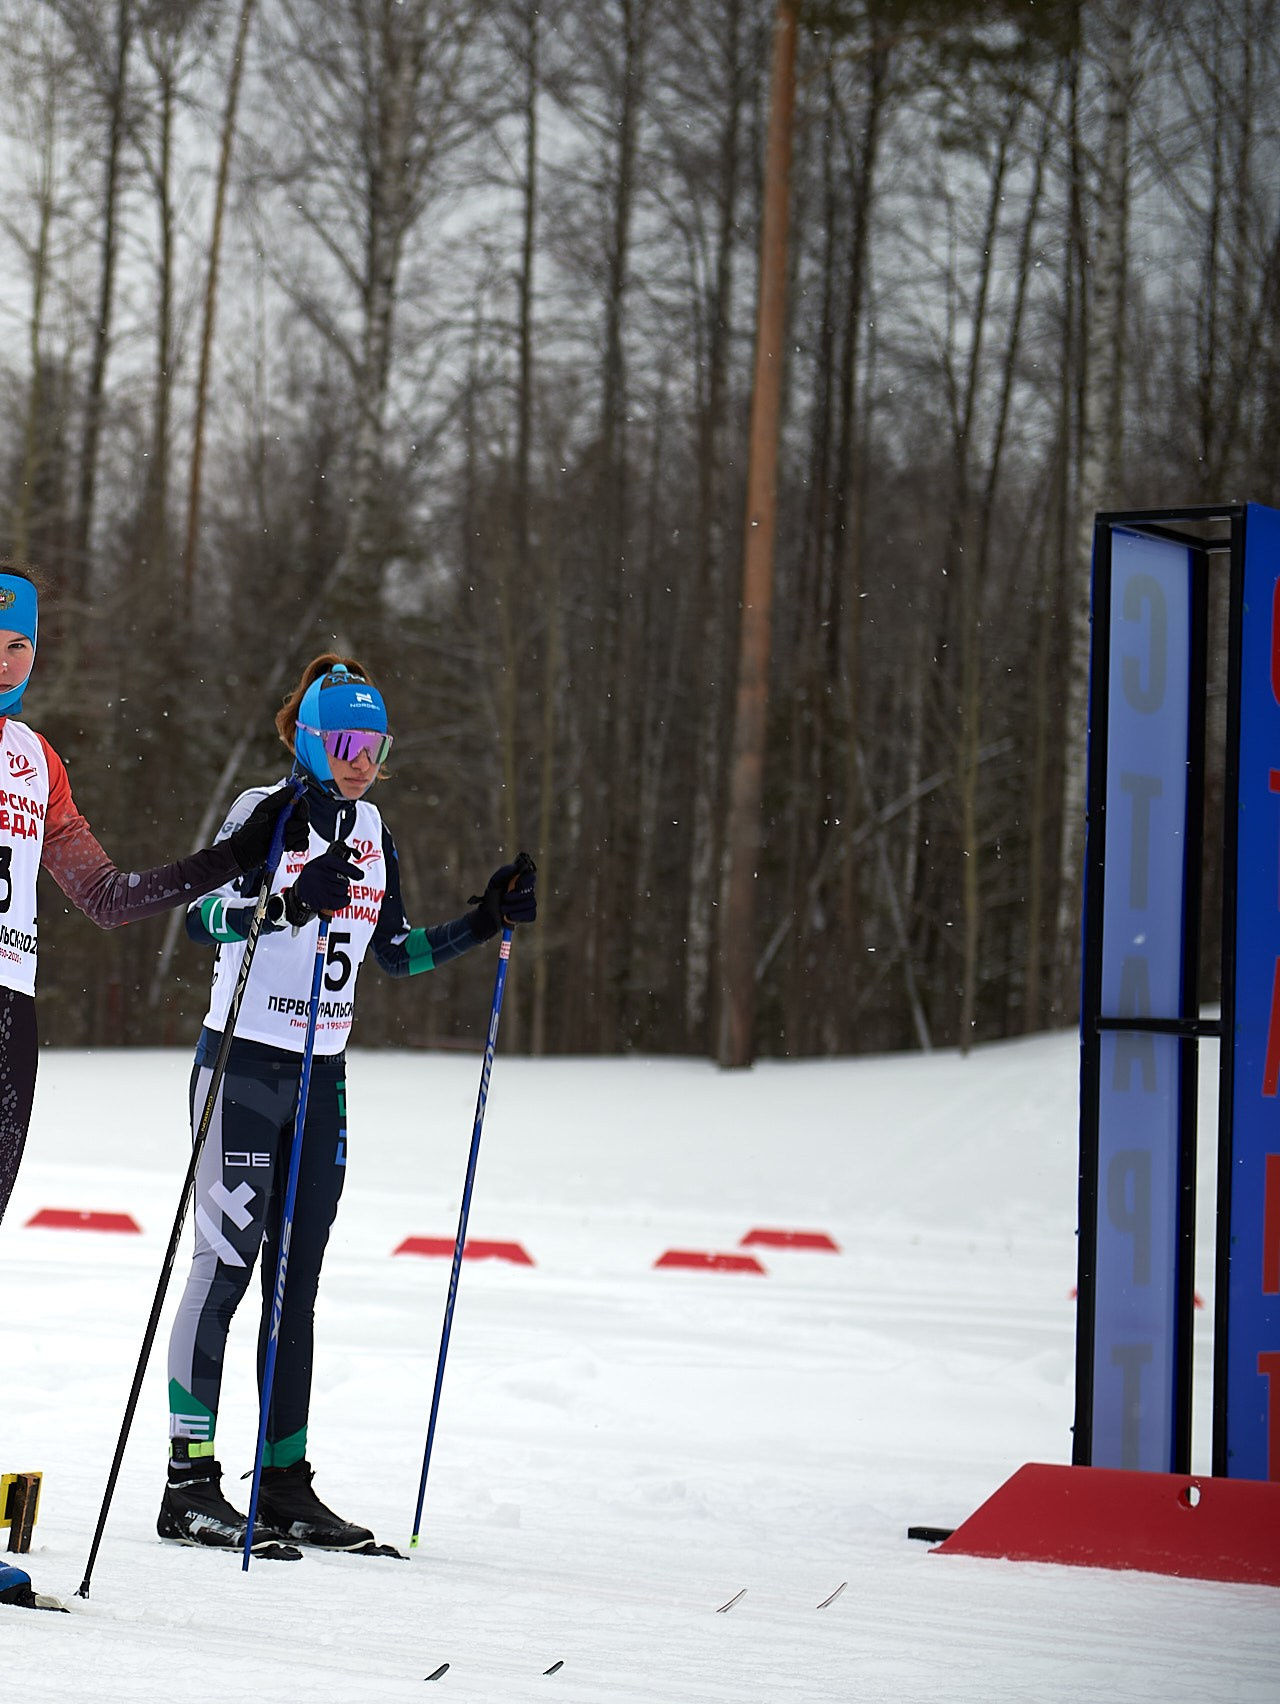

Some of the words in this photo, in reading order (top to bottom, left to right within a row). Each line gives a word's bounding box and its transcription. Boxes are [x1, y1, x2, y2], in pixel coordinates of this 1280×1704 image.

[6, 750, 30, 770] 70
[352, 838, 373, 855] 70
[324, 931, 352, 992] 5
